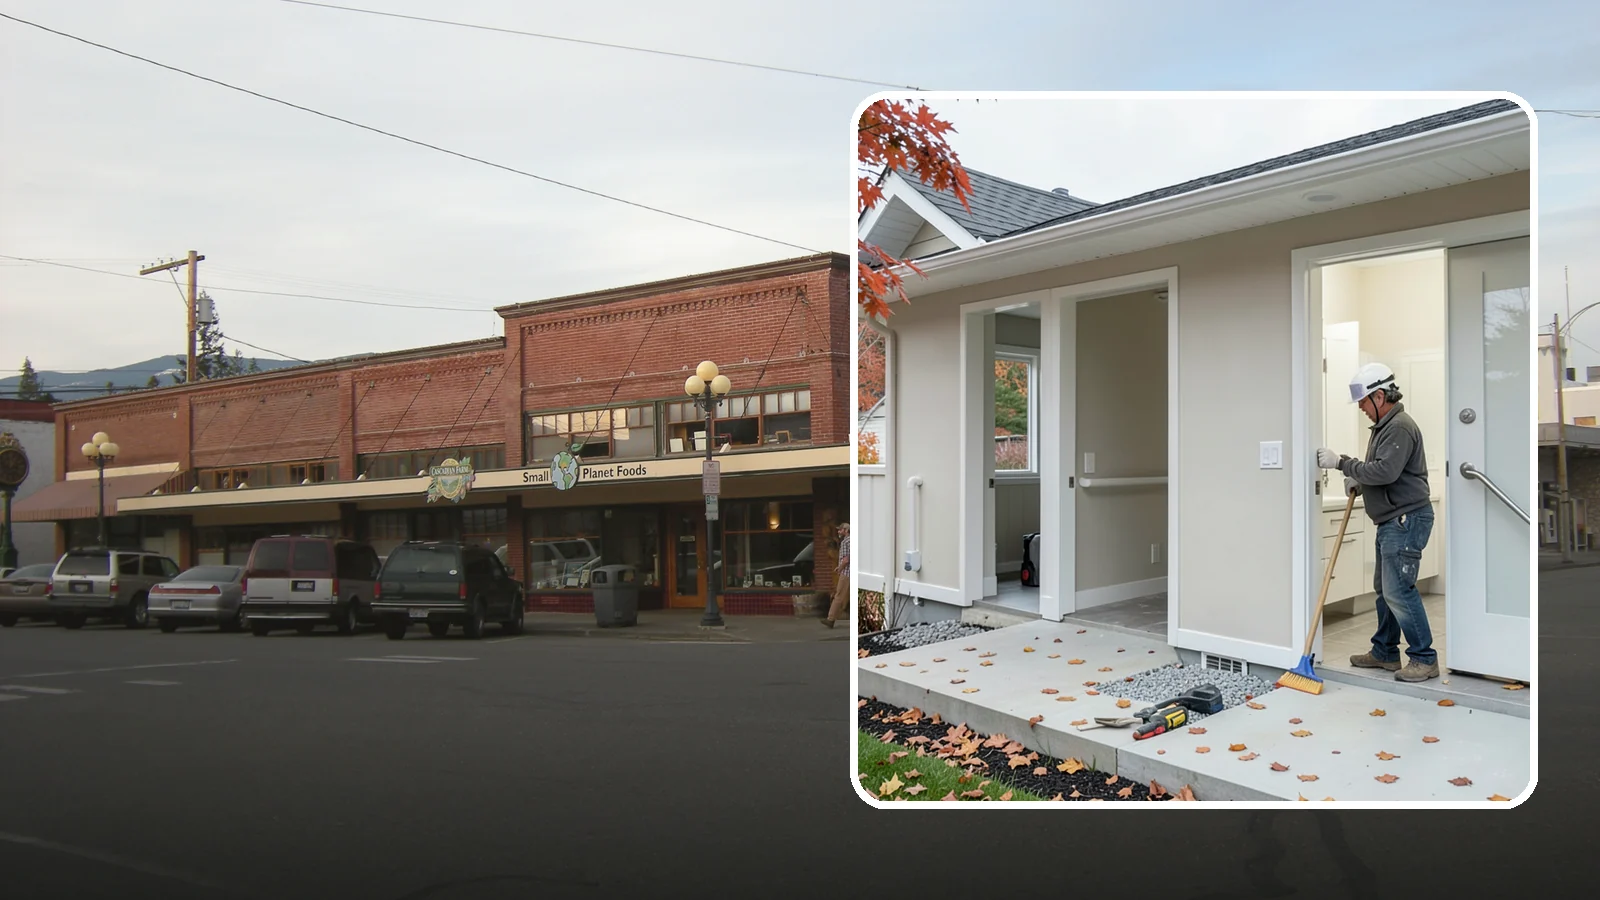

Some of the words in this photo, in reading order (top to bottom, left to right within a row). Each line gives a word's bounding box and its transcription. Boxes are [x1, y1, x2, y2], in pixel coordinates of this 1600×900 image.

[523, 471, 549, 483] Small
[583, 468, 614, 479] Planet
[617, 464, 647, 476] Foods
